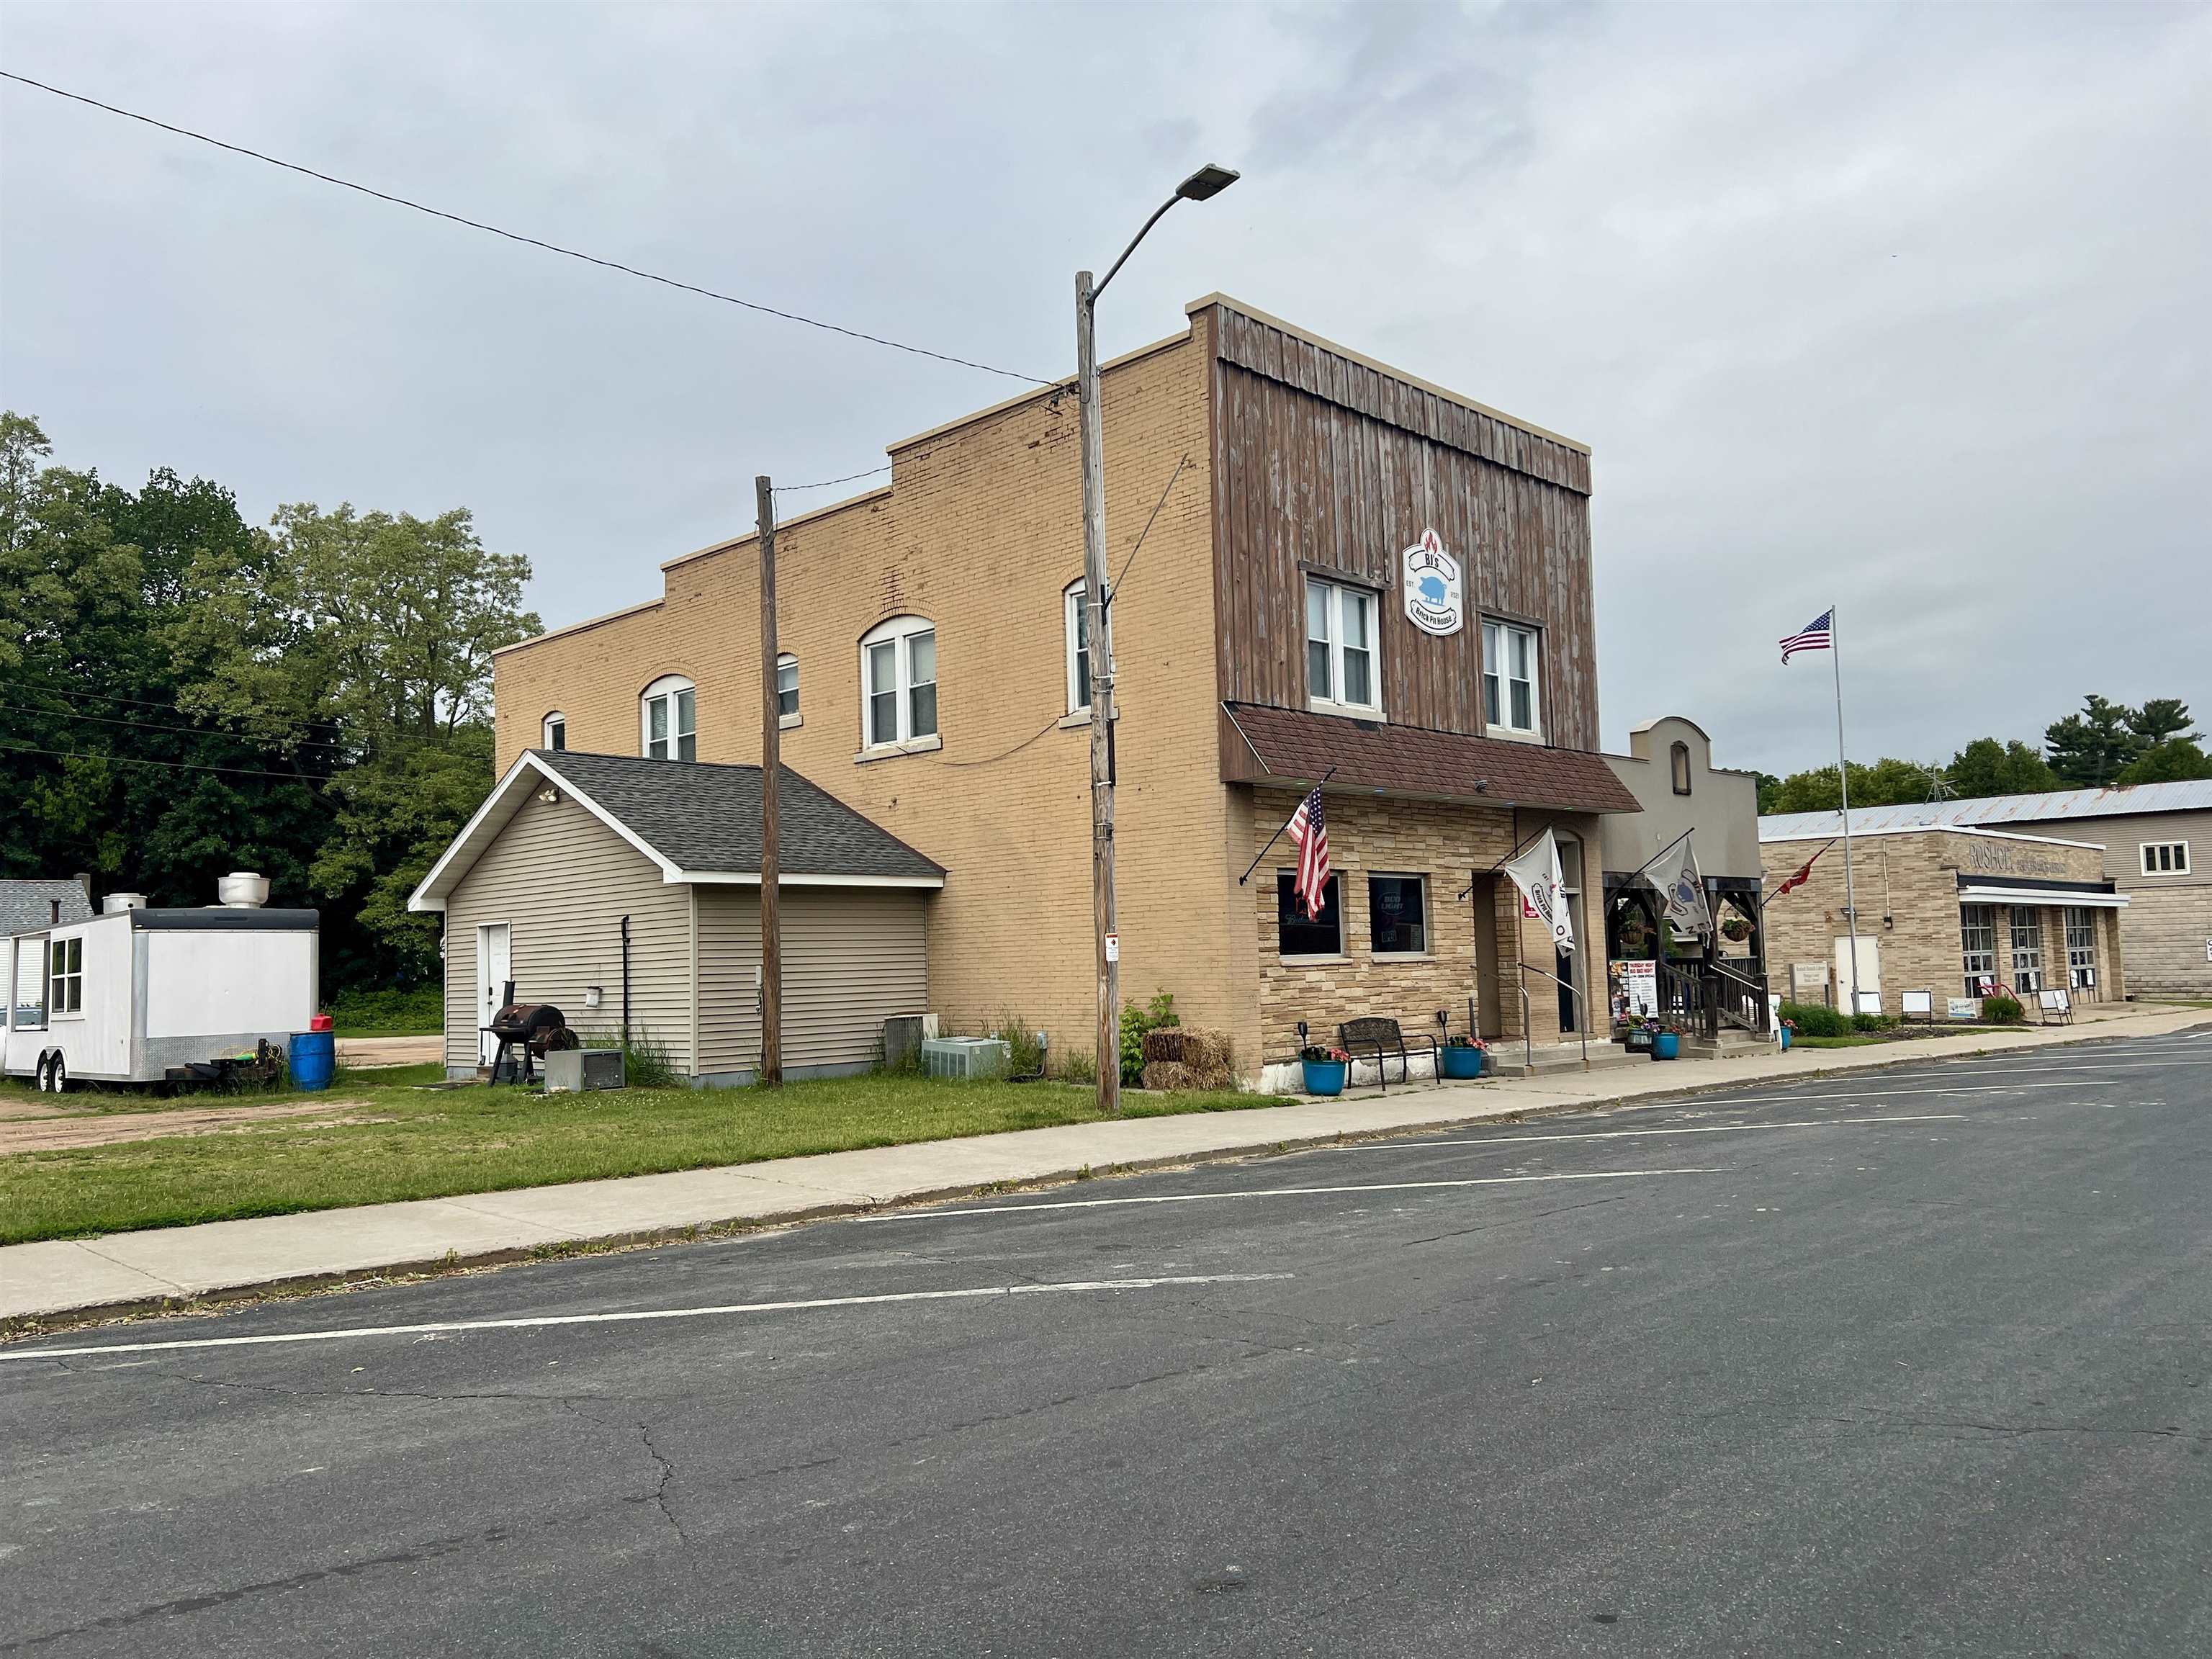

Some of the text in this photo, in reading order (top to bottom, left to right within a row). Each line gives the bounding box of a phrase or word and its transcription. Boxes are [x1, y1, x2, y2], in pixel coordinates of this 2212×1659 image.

[1416, 607, 1429, 621] Brick
[1437, 616, 1452, 625] House
[1534, 890, 1543, 904] Brick
